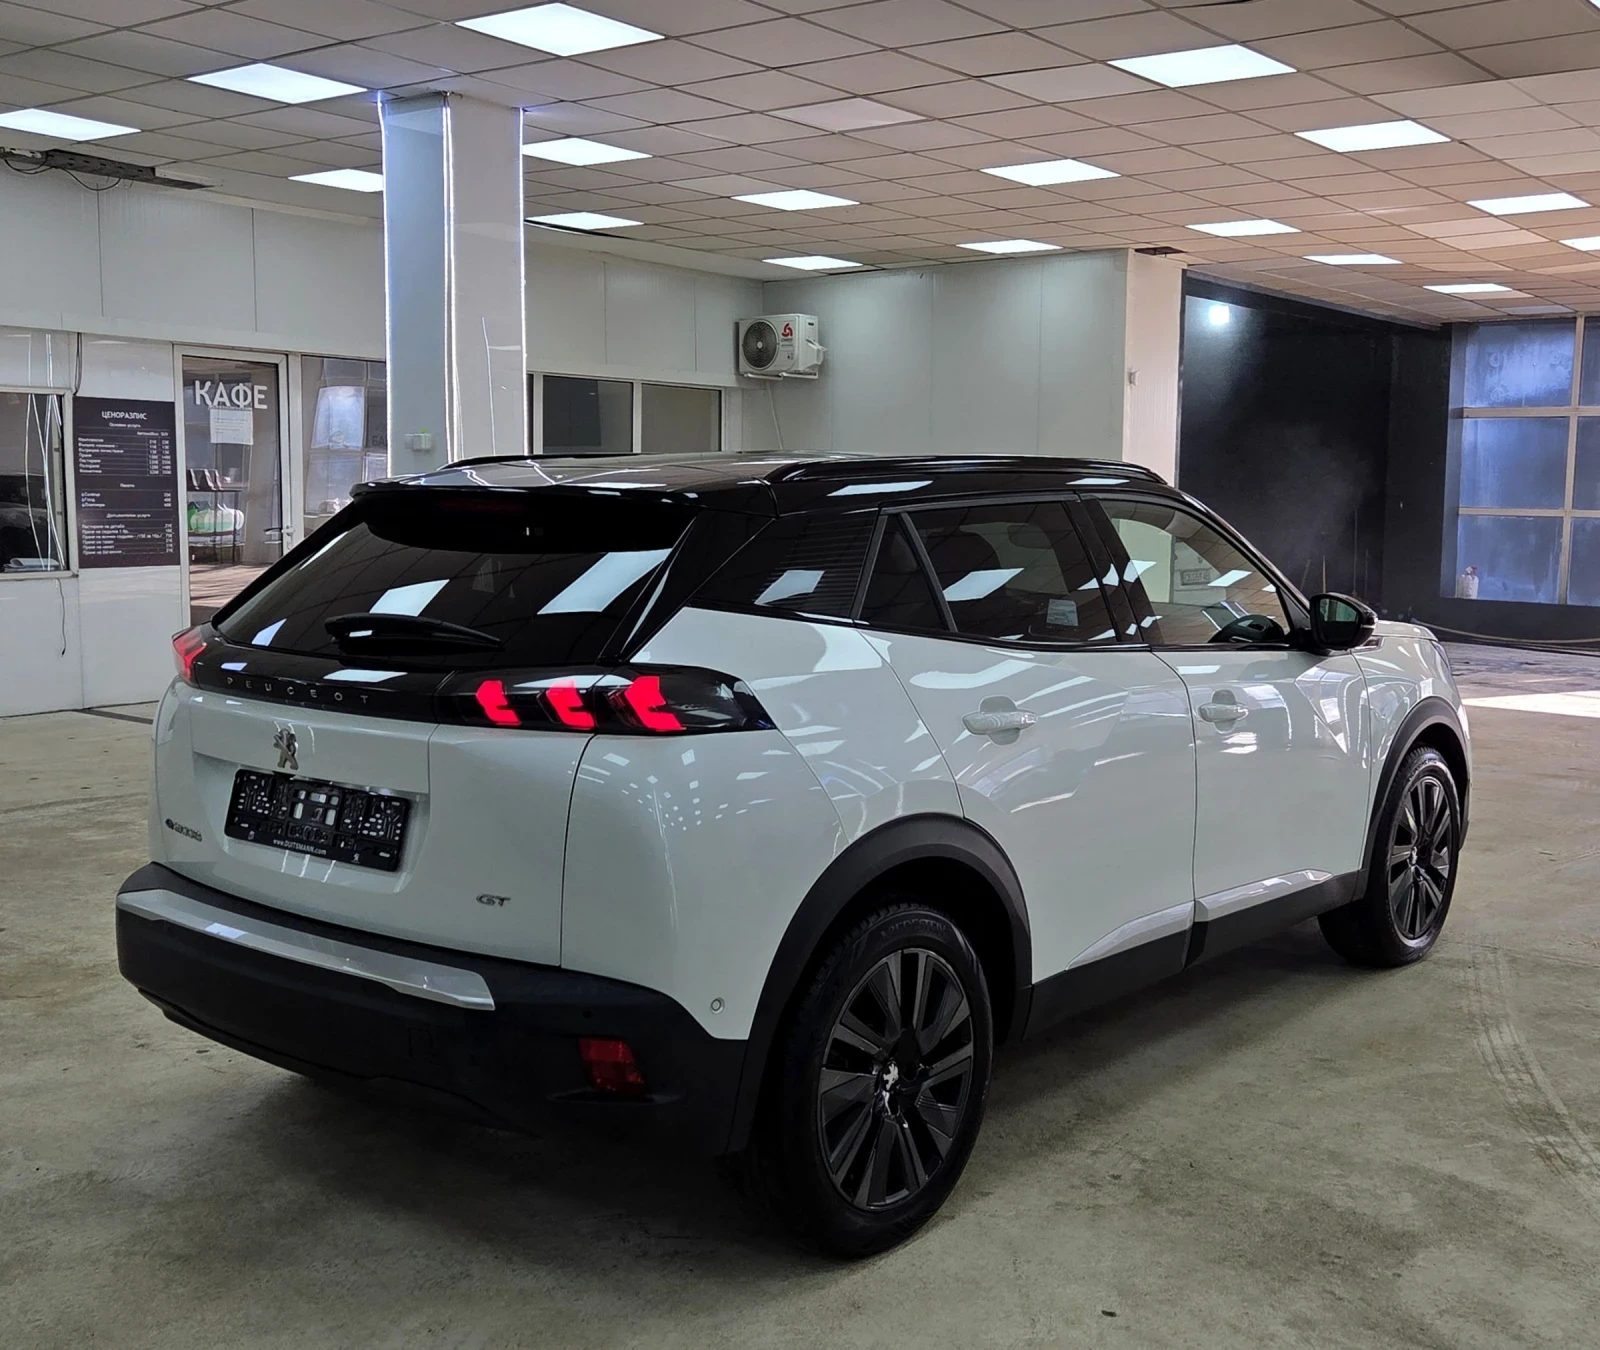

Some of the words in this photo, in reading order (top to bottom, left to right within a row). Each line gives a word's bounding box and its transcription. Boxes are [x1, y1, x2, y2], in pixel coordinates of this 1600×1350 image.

[195, 380, 268, 409] КАФЕ
[101, 411, 147, 420] ЦЕНОРАЗПИС
[227, 676, 369, 704] PEUGEOT
[475, 893, 511, 907] GT
